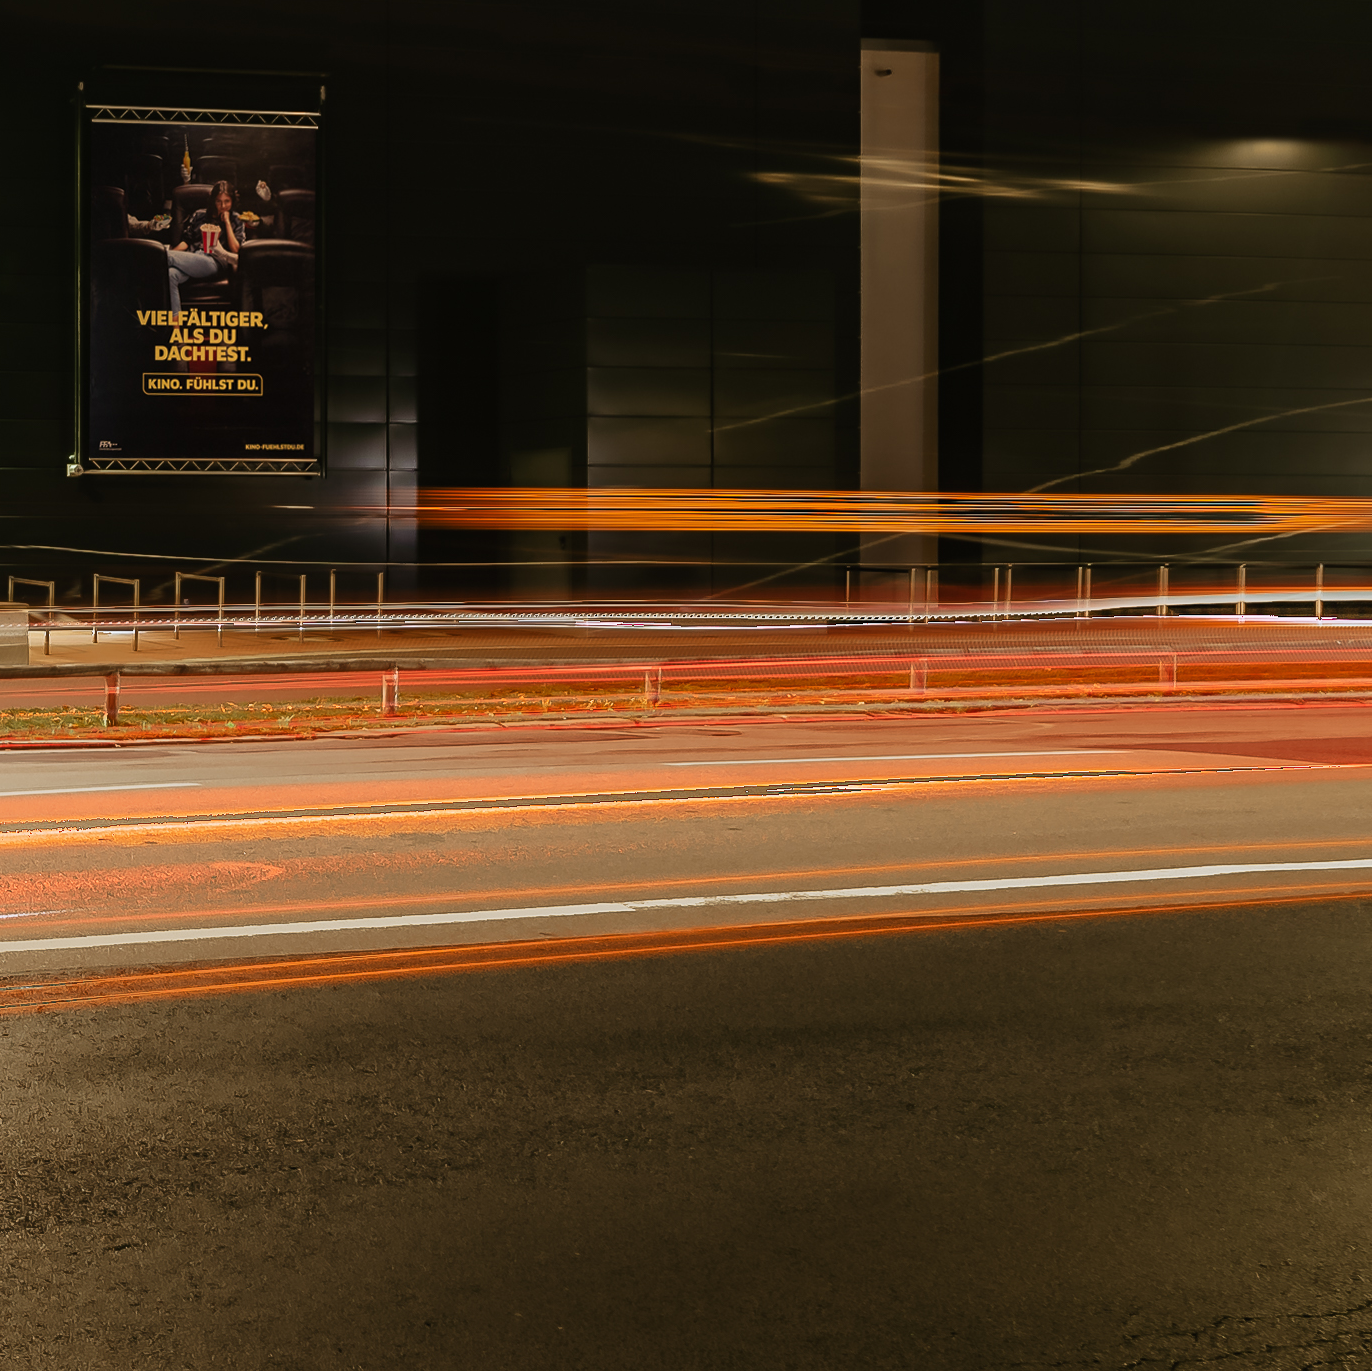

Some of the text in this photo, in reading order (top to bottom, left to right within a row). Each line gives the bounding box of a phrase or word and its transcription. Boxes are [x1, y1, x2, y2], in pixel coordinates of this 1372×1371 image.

[136, 308, 269, 330] VIELFÄLTIGER,
[168, 328, 238, 345] ALS DU
[154, 344, 252, 362] DACHTEST.
[147, 376, 259, 392] KINO. FÜHLST DU.
[245, 443, 306, 451] KINO-FUEHLSTDU.DE
